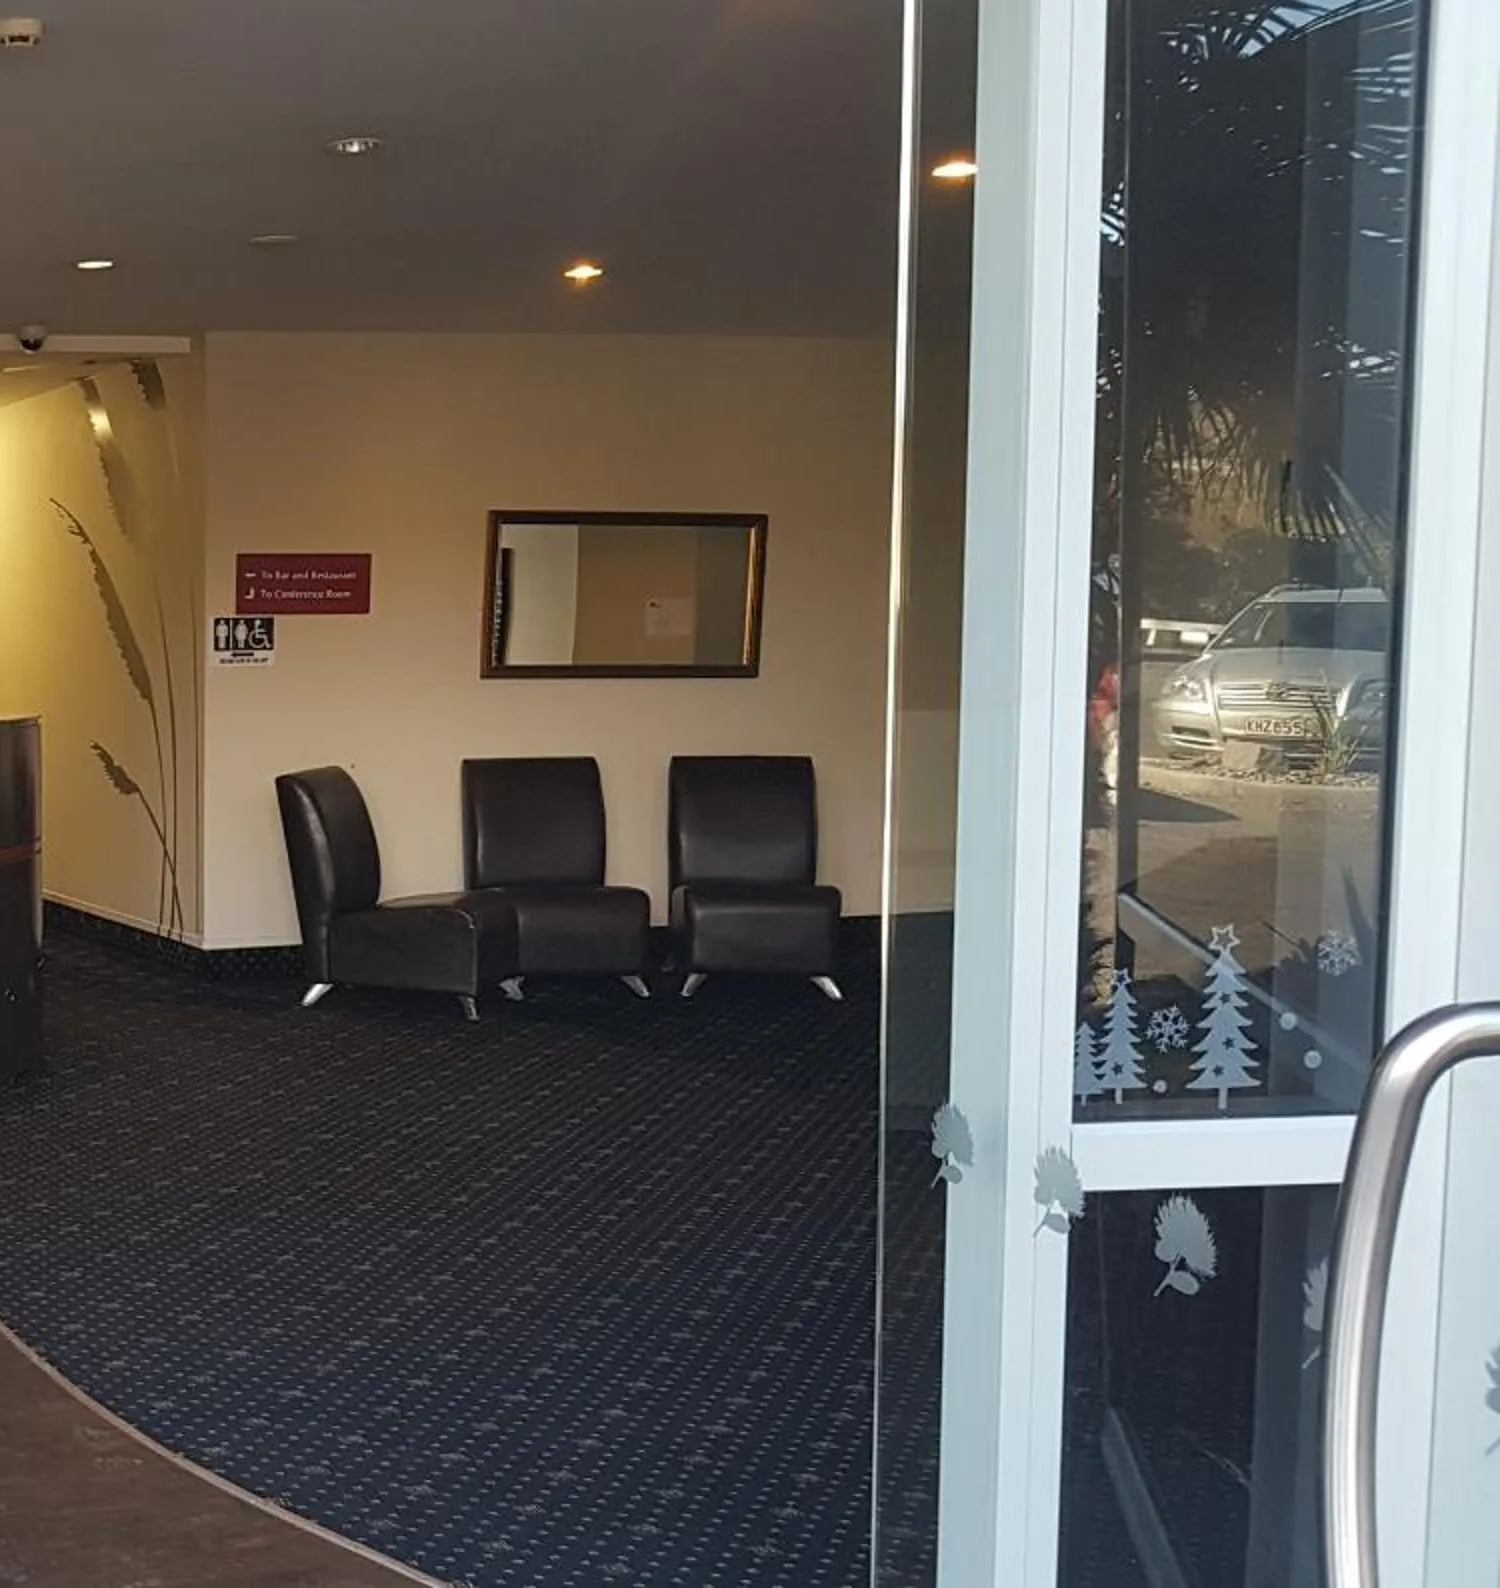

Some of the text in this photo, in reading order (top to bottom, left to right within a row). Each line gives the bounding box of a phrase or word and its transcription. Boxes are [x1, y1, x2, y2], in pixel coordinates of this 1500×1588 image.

[291, 570, 309, 579] and
[260, 589, 351, 599] To Conference Room
